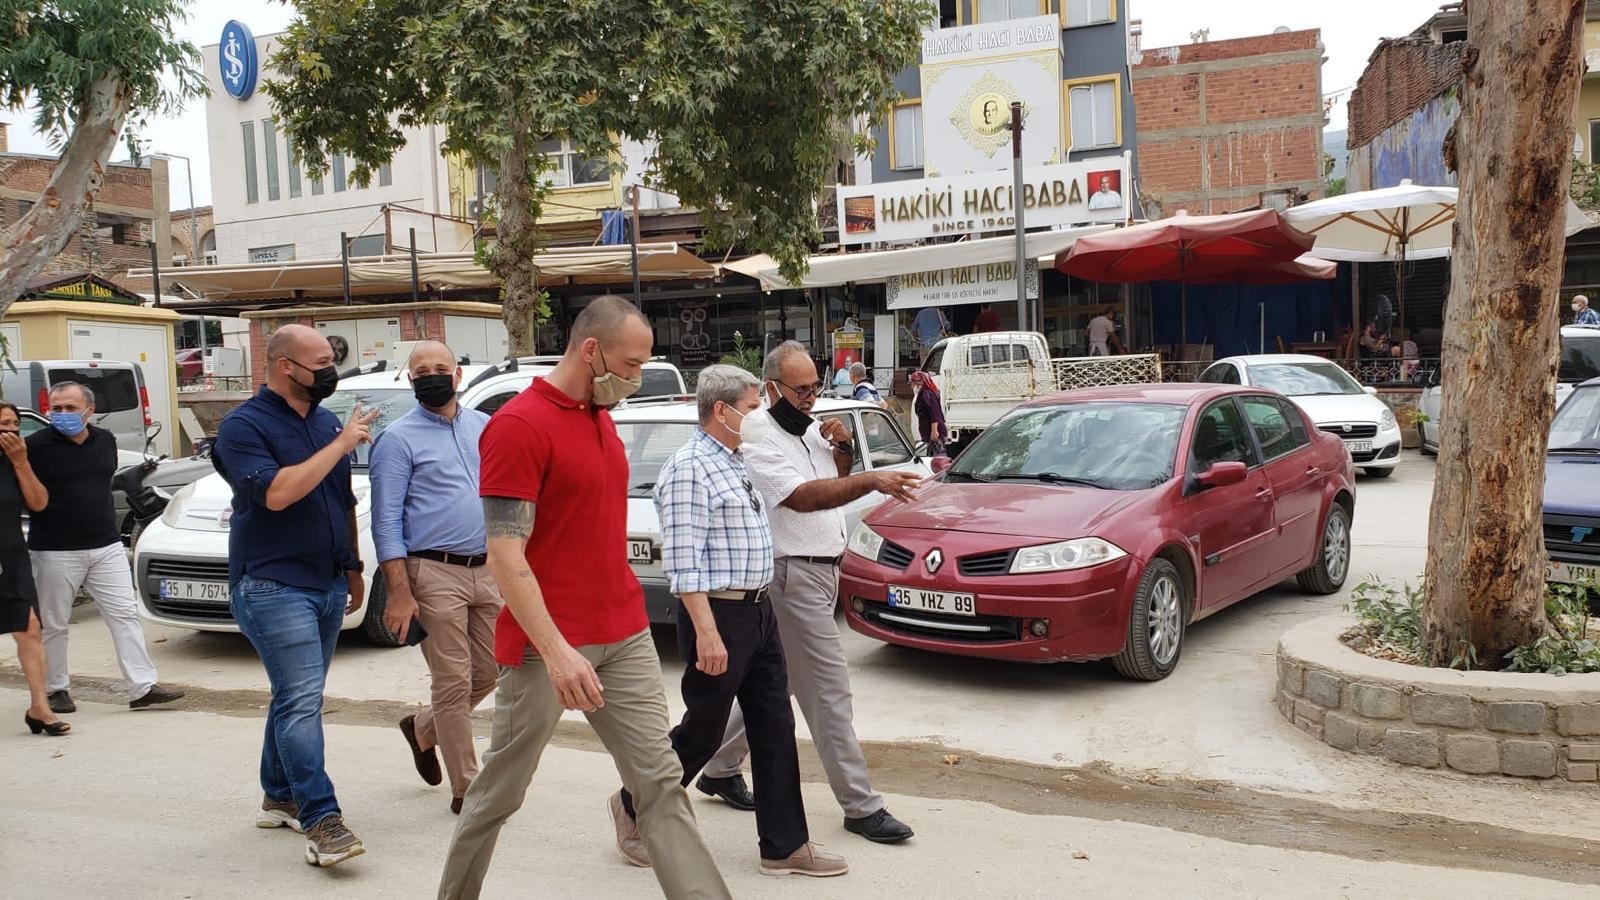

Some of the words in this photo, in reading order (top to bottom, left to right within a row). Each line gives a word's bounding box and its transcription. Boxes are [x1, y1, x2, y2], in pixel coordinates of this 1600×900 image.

[1016, 23, 1055, 46] BABA
[1023, 178, 1083, 209] BABA
[982, 217, 1015, 228] 1940
[633, 543, 649, 558] 04
[167, 581, 179, 596] 35
[201, 583, 227, 600] 7674
[896, 589, 911, 605] 35
[920, 591, 945, 610] YHZ
[954, 596, 972, 612] 89
